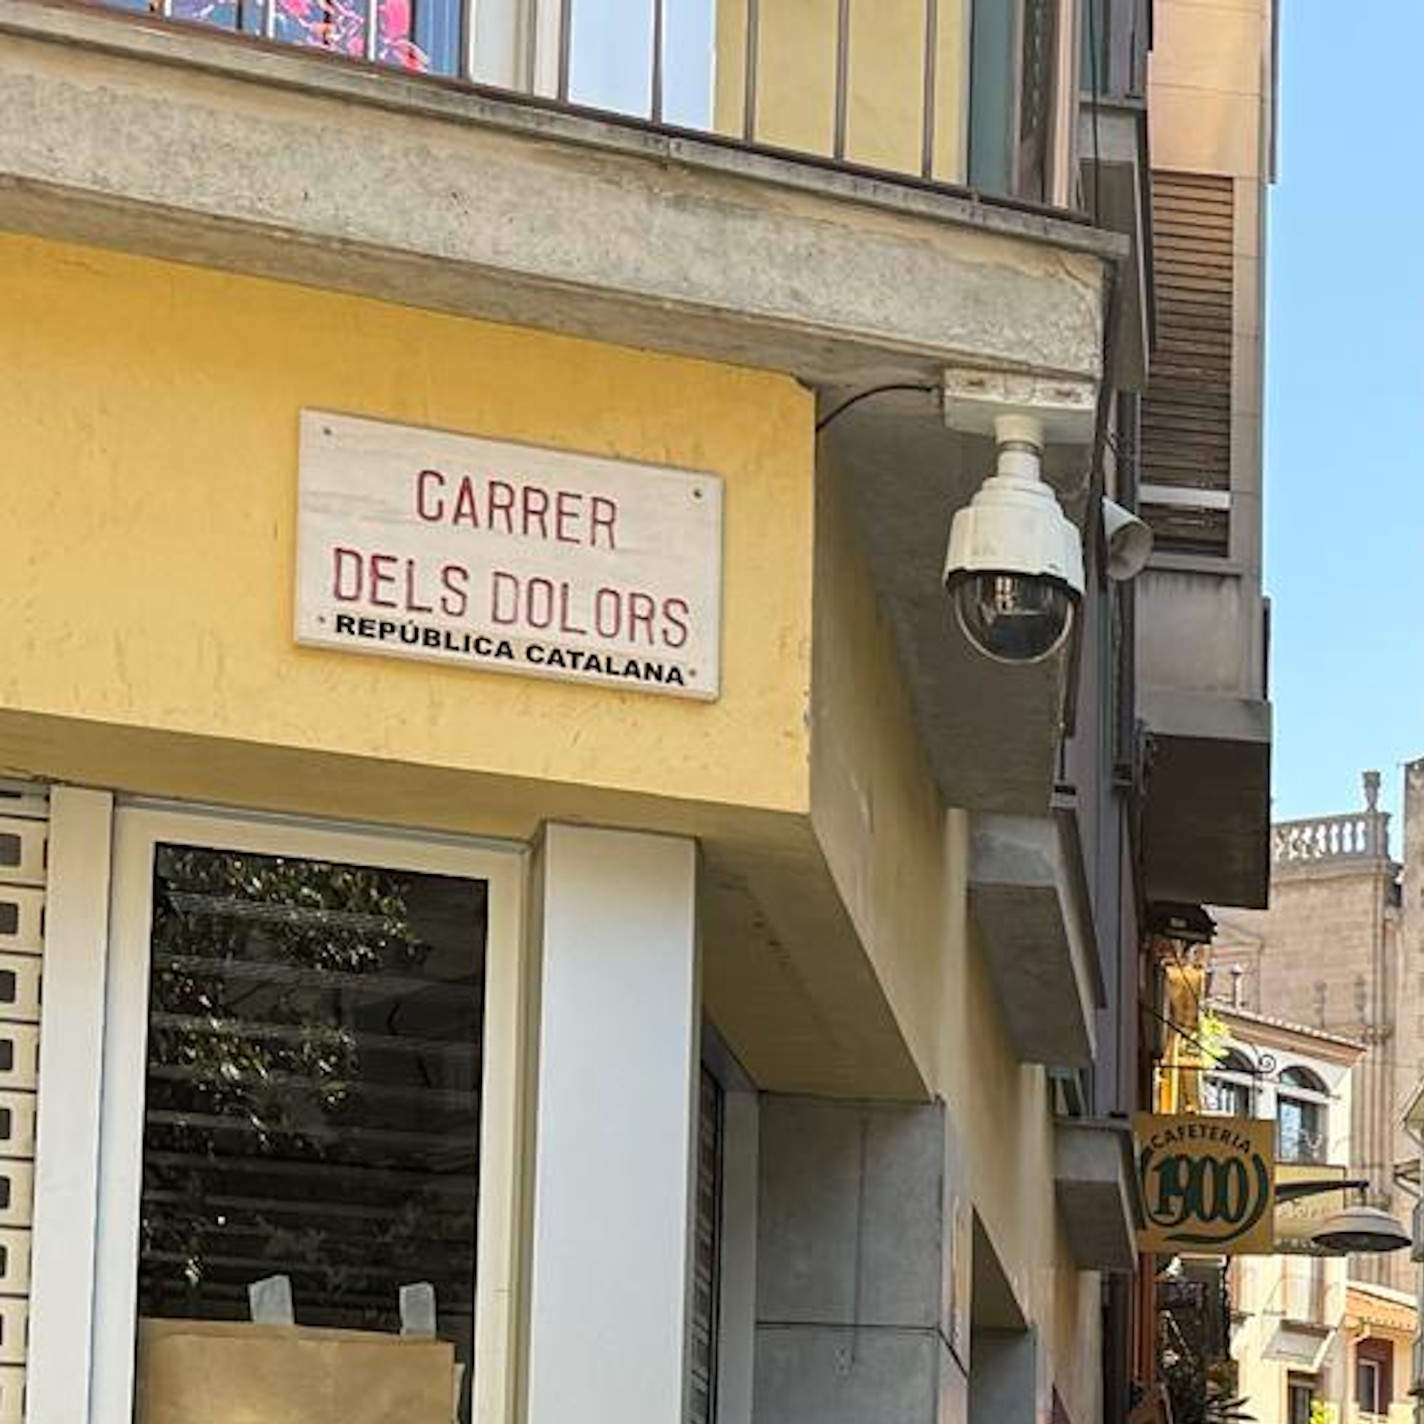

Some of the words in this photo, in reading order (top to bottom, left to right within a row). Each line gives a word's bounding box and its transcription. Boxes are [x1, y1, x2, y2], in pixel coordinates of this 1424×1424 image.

[416, 469, 618, 551] CARRER
[332, 546, 470, 618] DELS
[491, 570, 690, 649] DOLORS
[335, 613, 515, 660] REPÚBLICA
[526, 645, 686, 686] CATALANA
[1151, 1124, 1251, 1154] CAFETERIA
[1145, 1154, 1249, 1228] 1900
